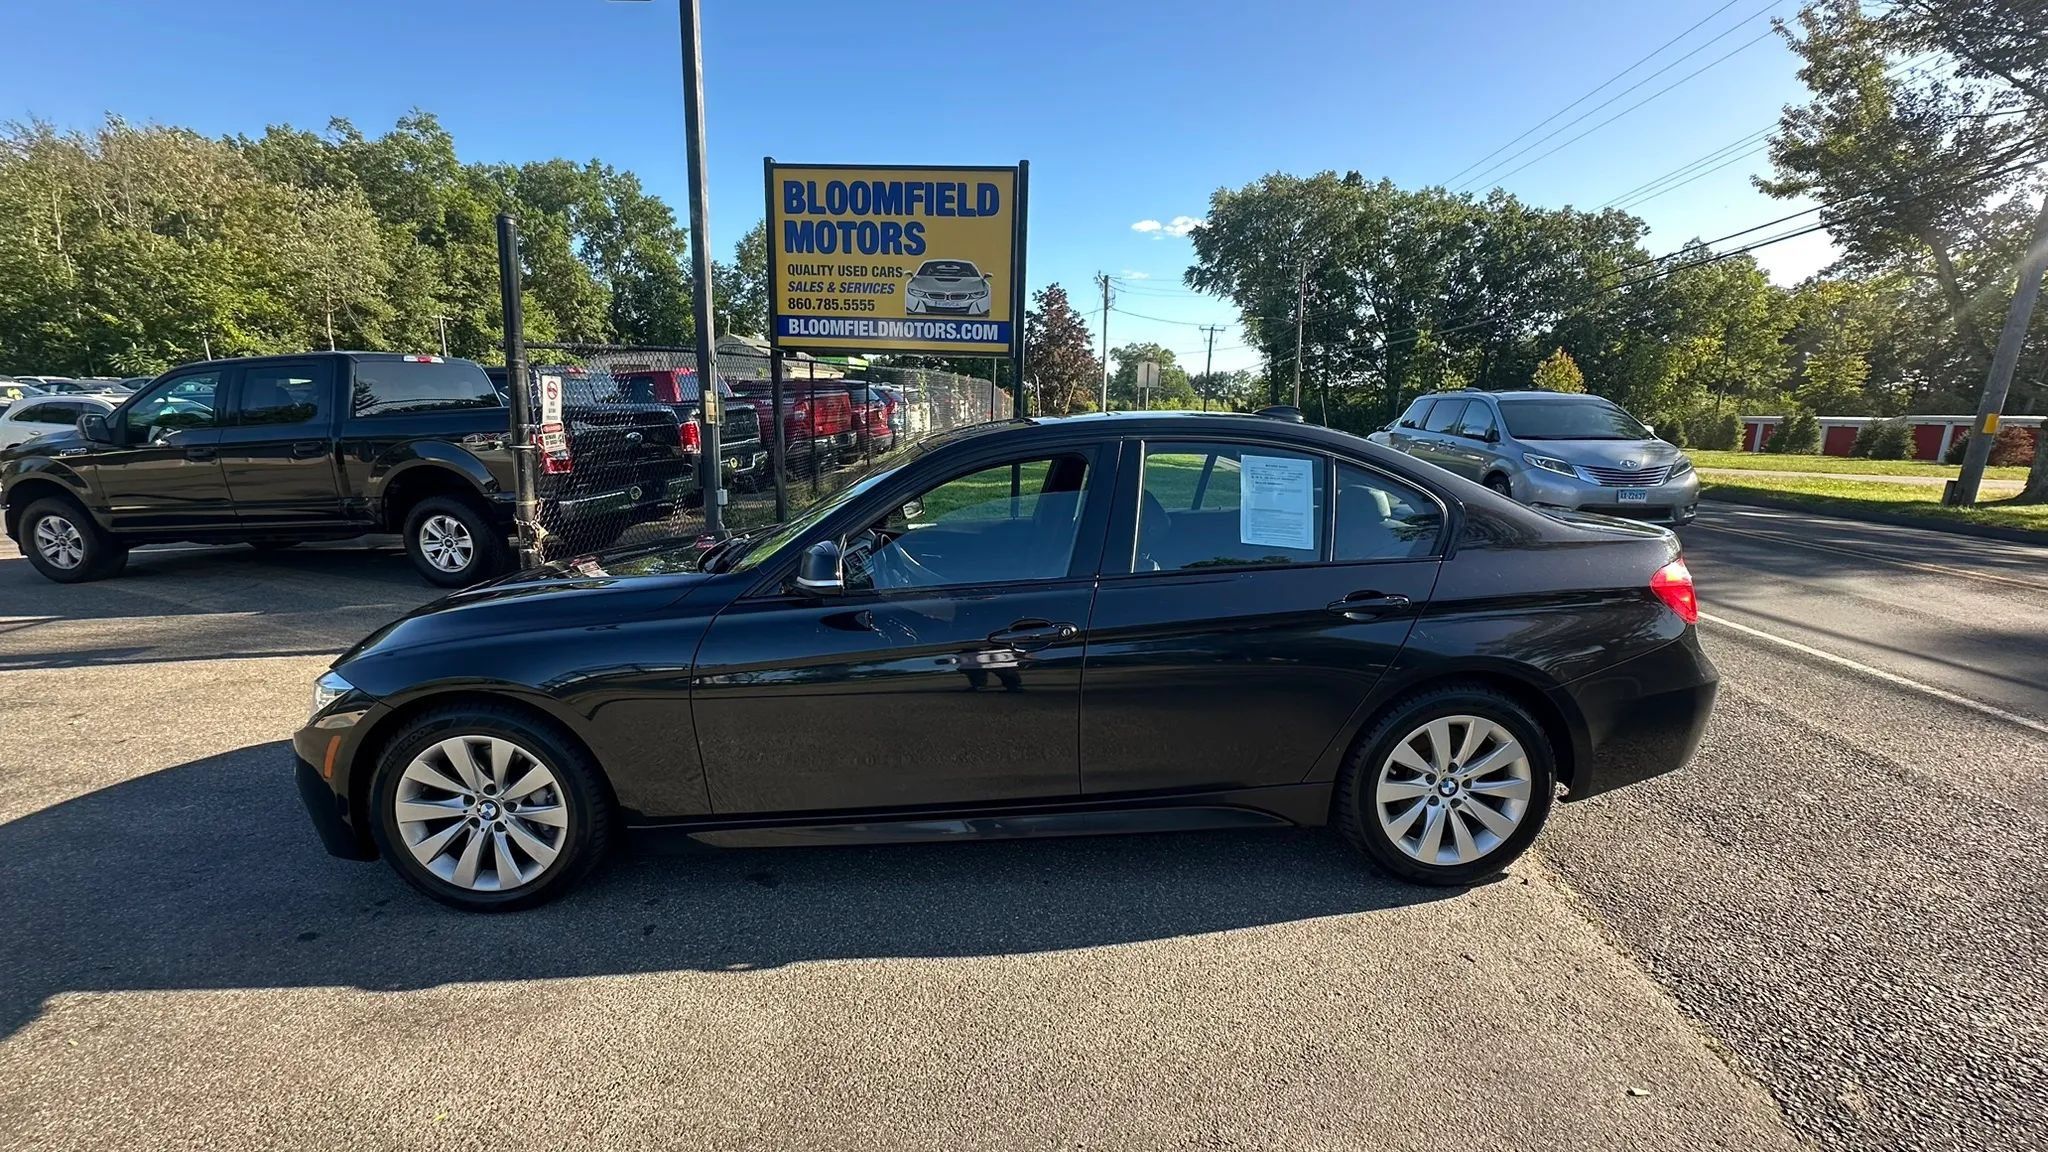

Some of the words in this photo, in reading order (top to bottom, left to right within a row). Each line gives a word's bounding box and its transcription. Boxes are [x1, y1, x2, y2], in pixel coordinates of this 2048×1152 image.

[783, 180, 1000, 217] BLOOMFIELD
[783, 220, 927, 256] MOTORS
[787, 264, 834, 277] QUALITY
[838, 265, 868, 277] USED
[872, 266, 903, 278] CARS
[788, 281, 824, 293] SALES
[827, 282, 836, 293] &
[839, 282, 895, 295] SERVICES
[788, 298, 875, 312] 860.785.5555
[788, 318, 998, 341] BLOOMFIELDMOTORS.COM
